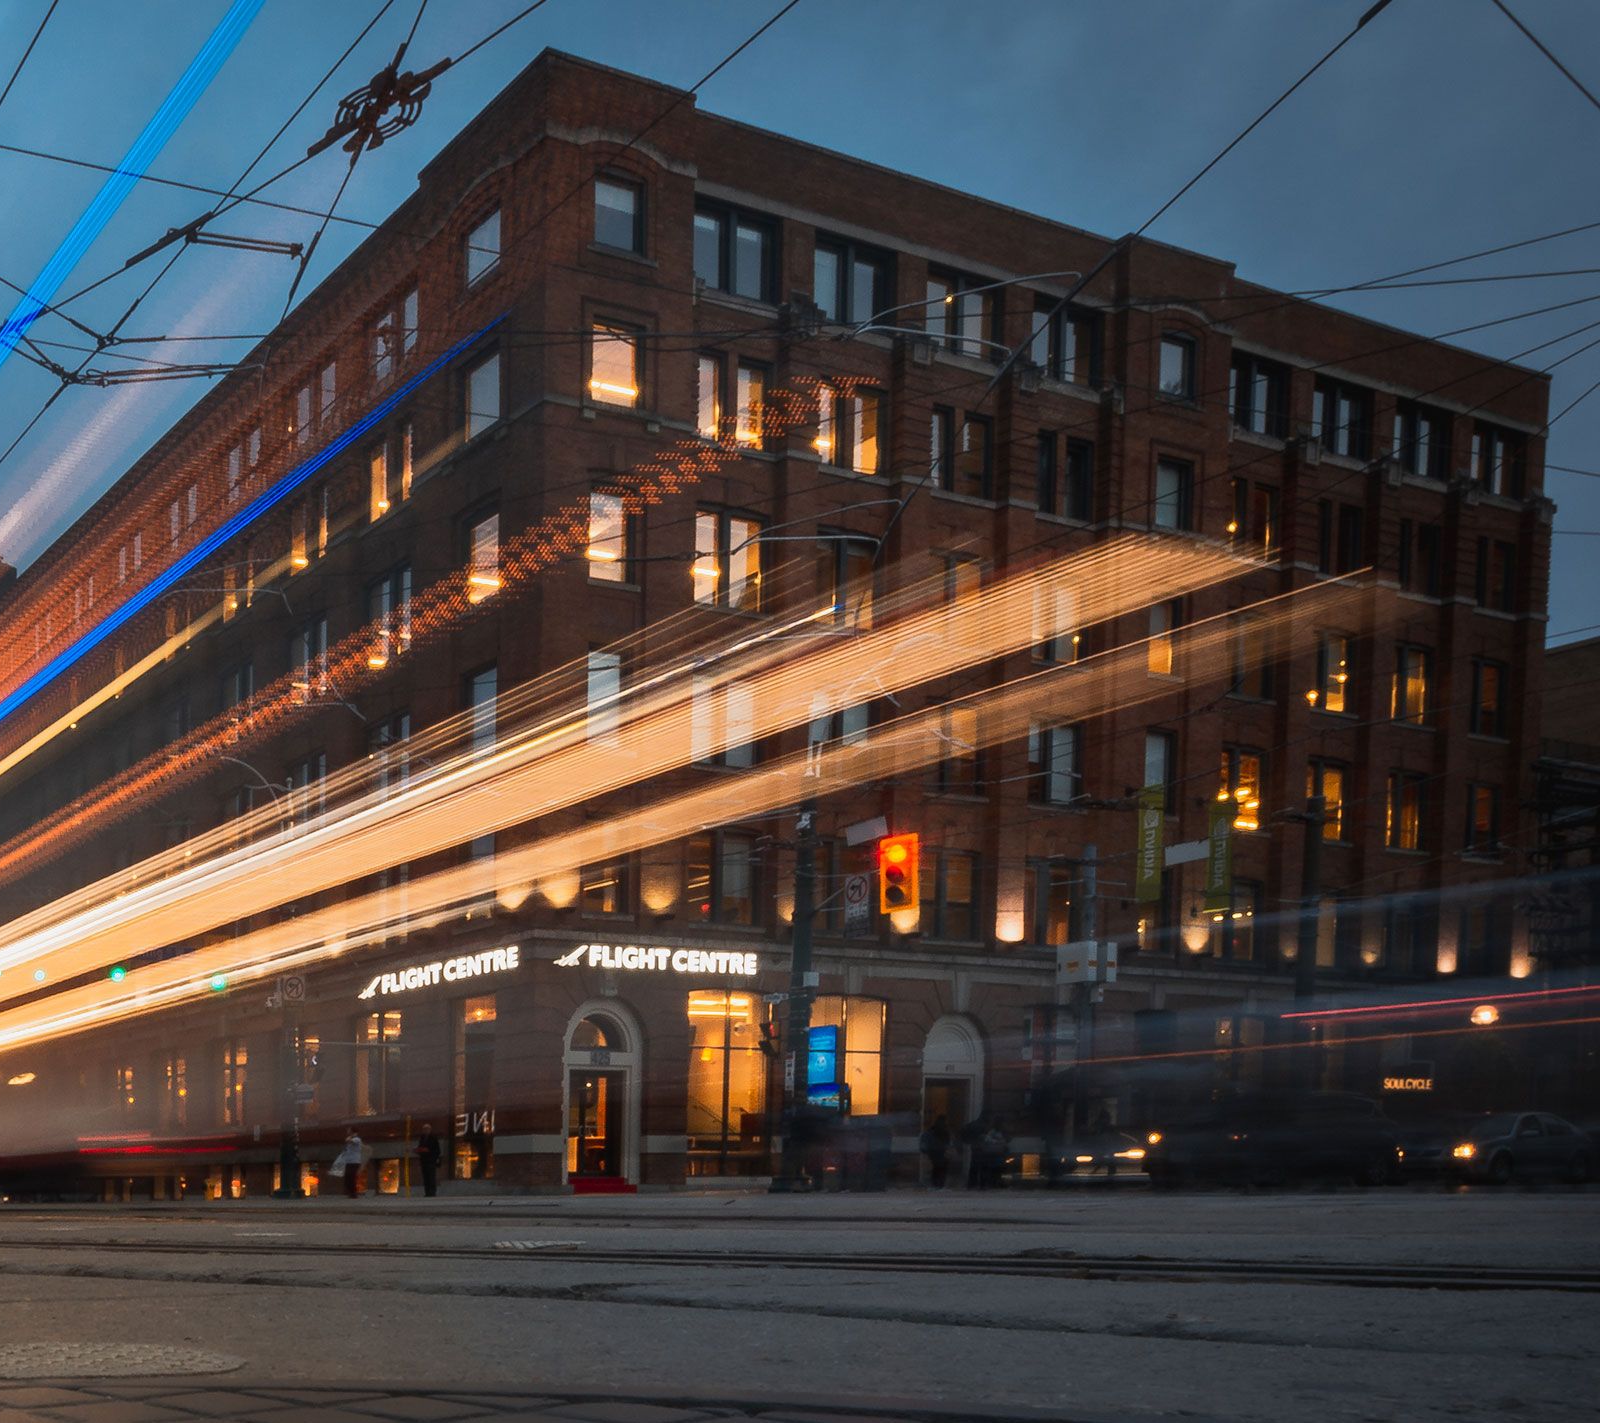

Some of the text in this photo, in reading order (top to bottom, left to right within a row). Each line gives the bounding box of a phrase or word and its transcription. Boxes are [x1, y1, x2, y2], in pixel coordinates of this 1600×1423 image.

[380, 945, 520, 995] FLIGHT CENTRE
[588, 944, 758, 976] FLIGHT CENTRE
[1383, 1077, 1434, 1090] SOULCYCLE
